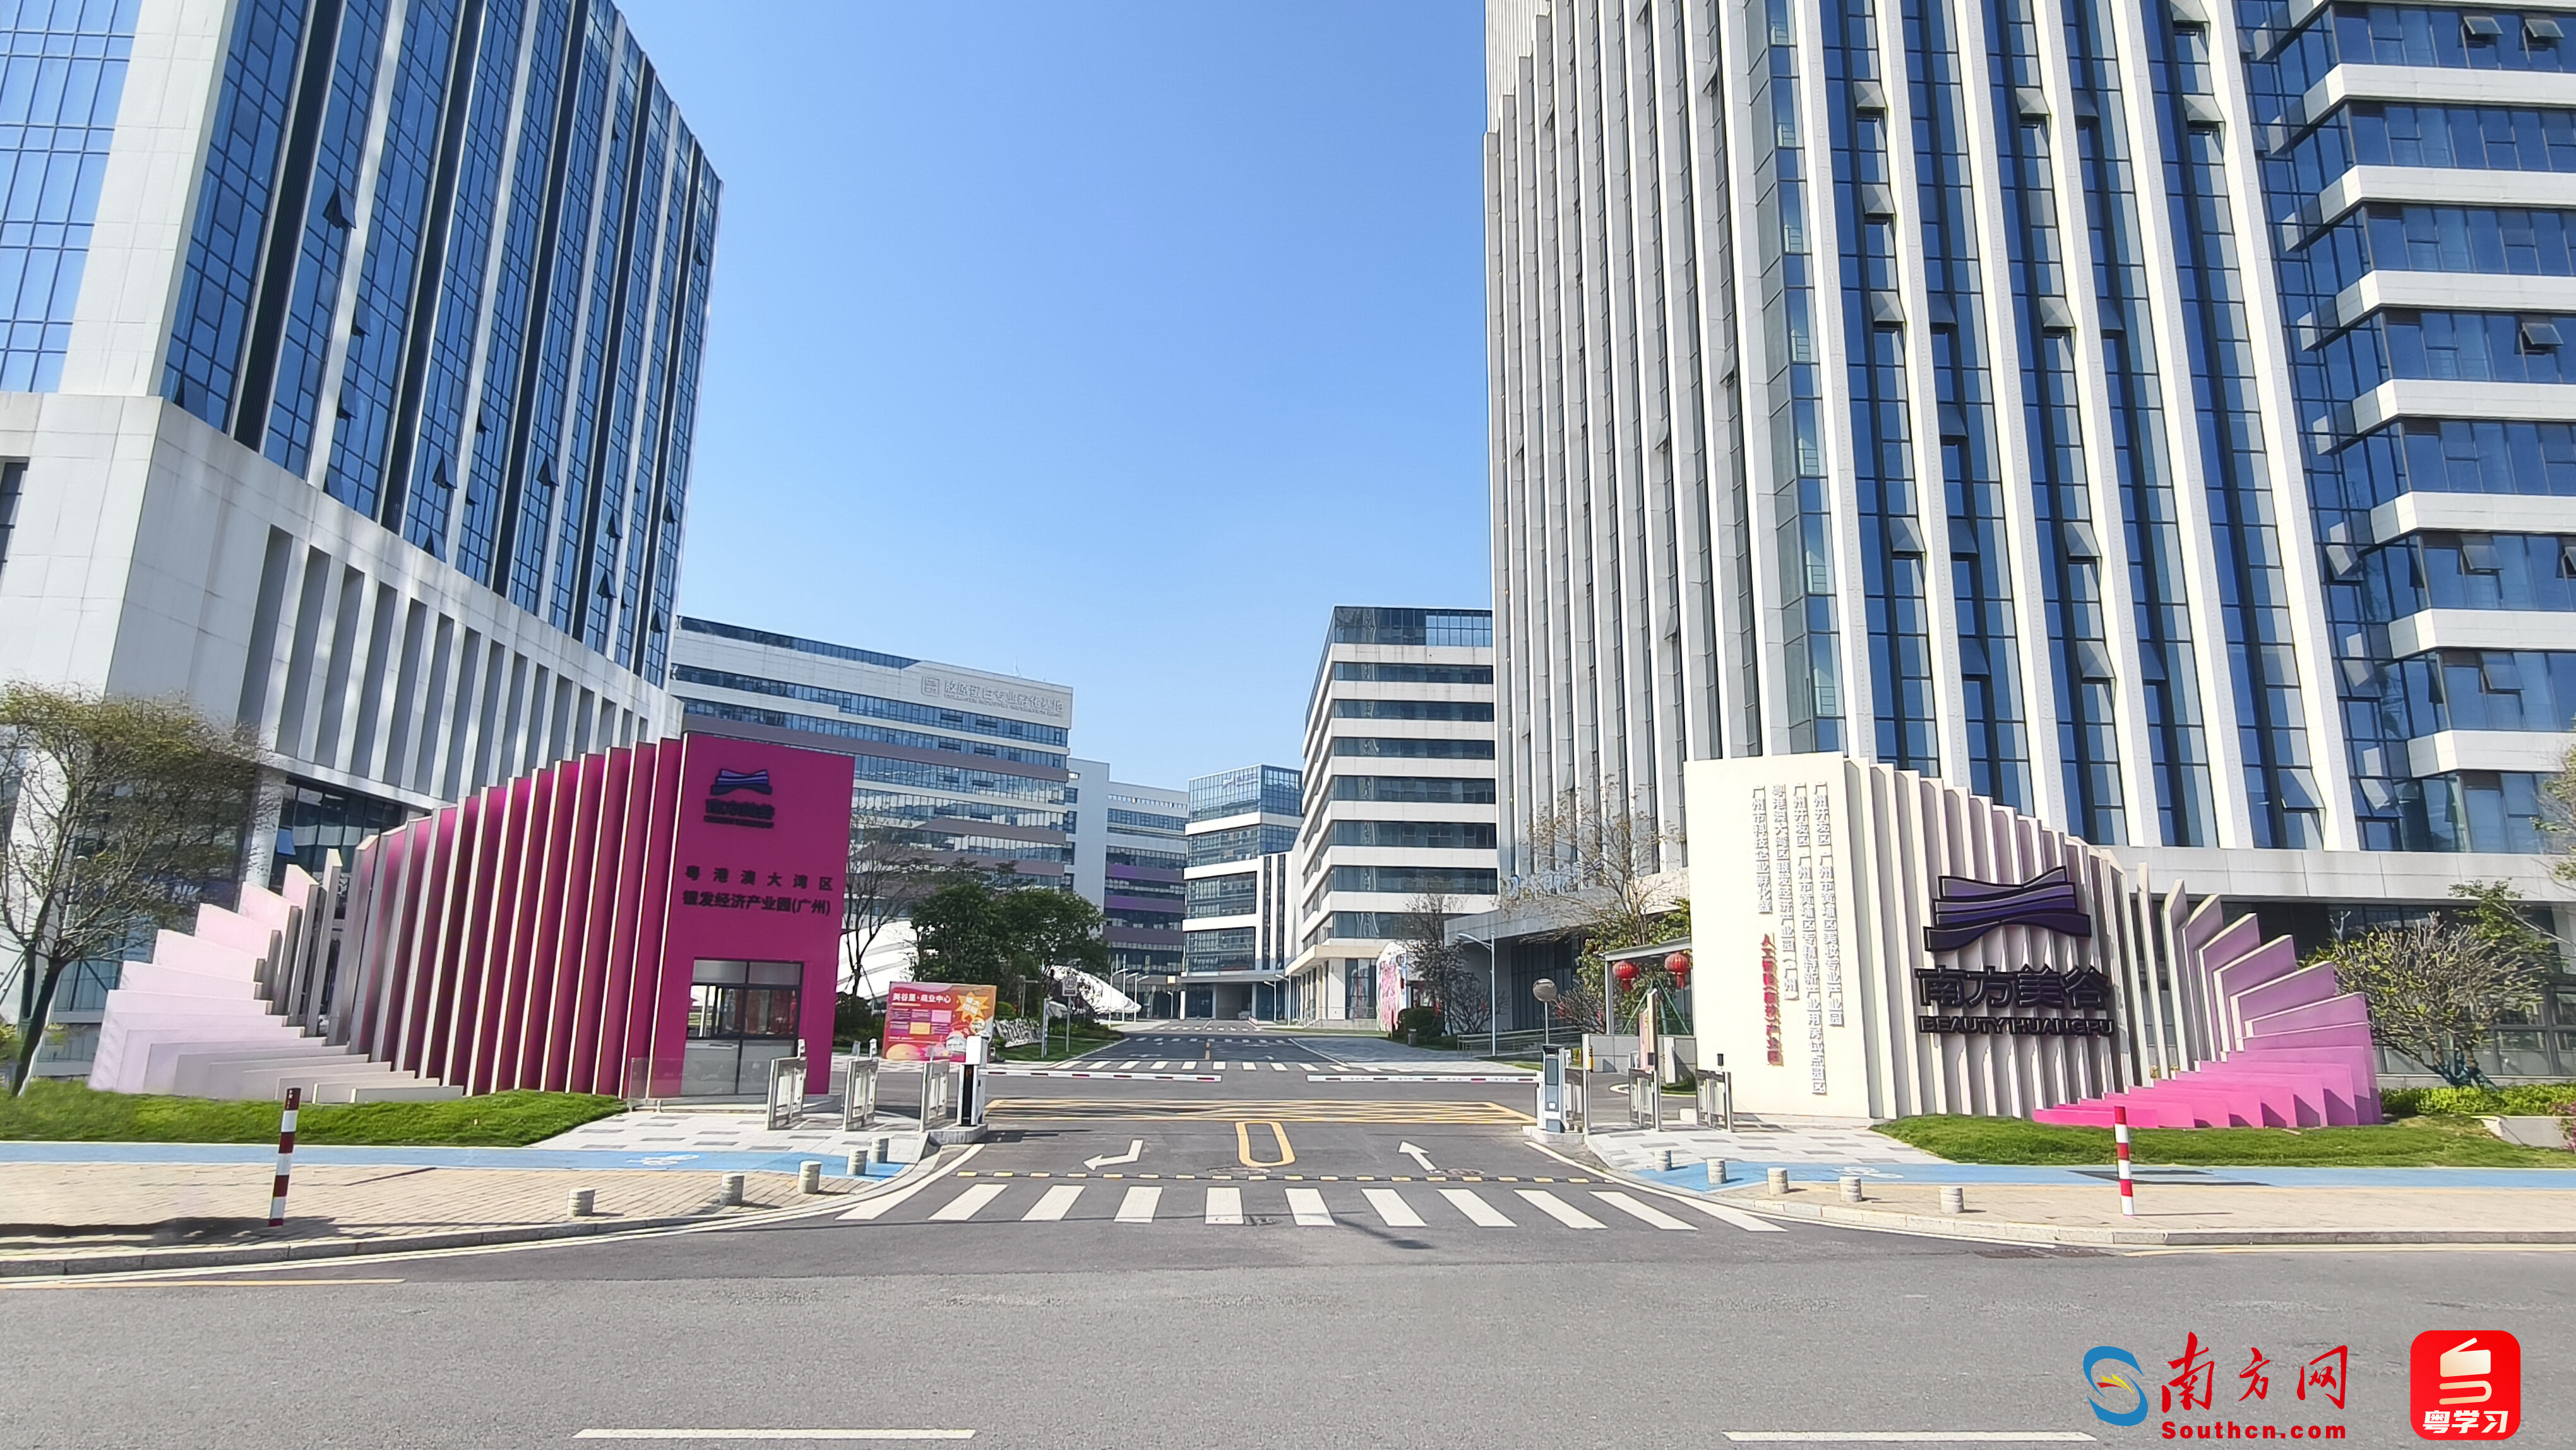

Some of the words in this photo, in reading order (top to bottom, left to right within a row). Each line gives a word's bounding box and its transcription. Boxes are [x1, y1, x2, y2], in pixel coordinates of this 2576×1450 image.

[685, 865, 833, 891] 粤港澳大湾区
[1914, 964, 2113, 1009] 南方美谷
[1917, 1015, 2005, 1034] BEAUTY
[2008, 1017, 2115, 1038] HUANGPU
